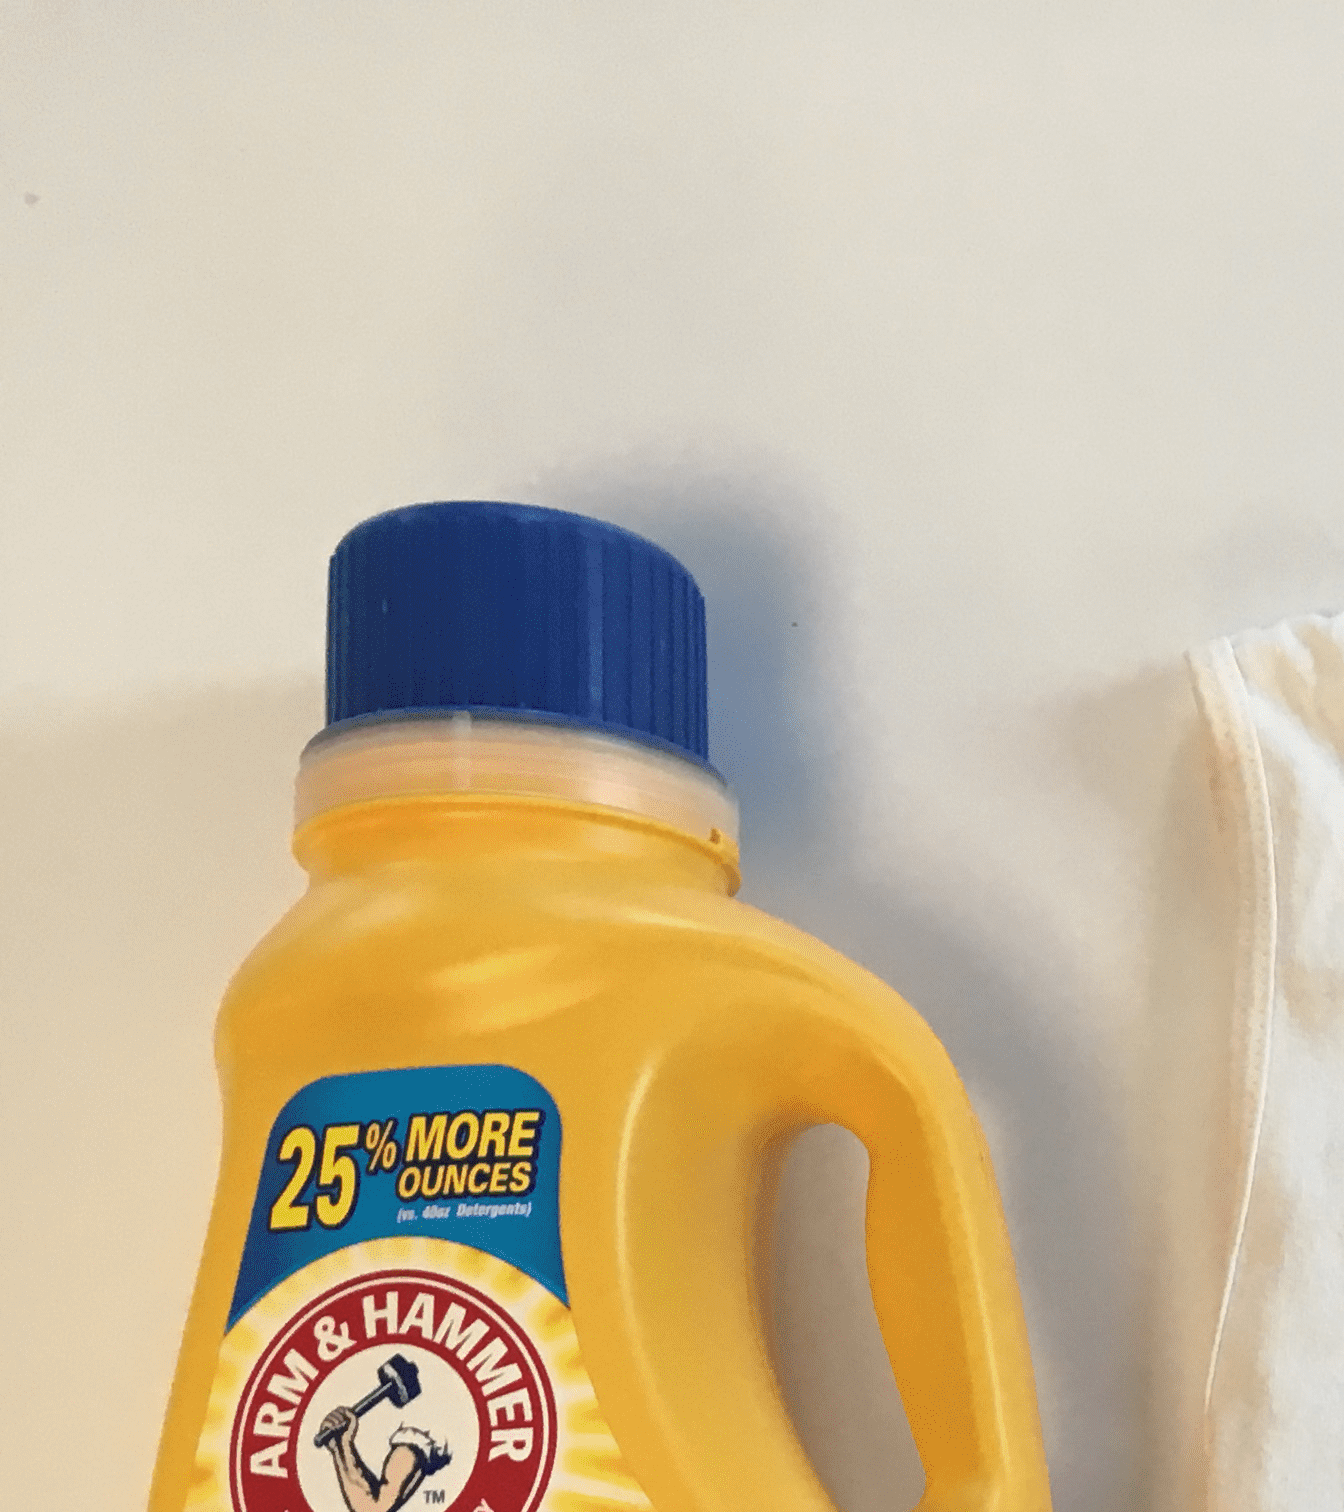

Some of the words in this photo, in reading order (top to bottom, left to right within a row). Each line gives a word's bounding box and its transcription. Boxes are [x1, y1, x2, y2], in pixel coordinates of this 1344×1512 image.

[405, 1111, 541, 1162] MORE
[398, 1161, 532, 1199] OUNCES
[250, 1349, 320, 1479] ARM
[314, 1314, 358, 1363] &
[361, 1290, 534, 1464] HAMMER
[423, 1489, 445, 1504] TM
